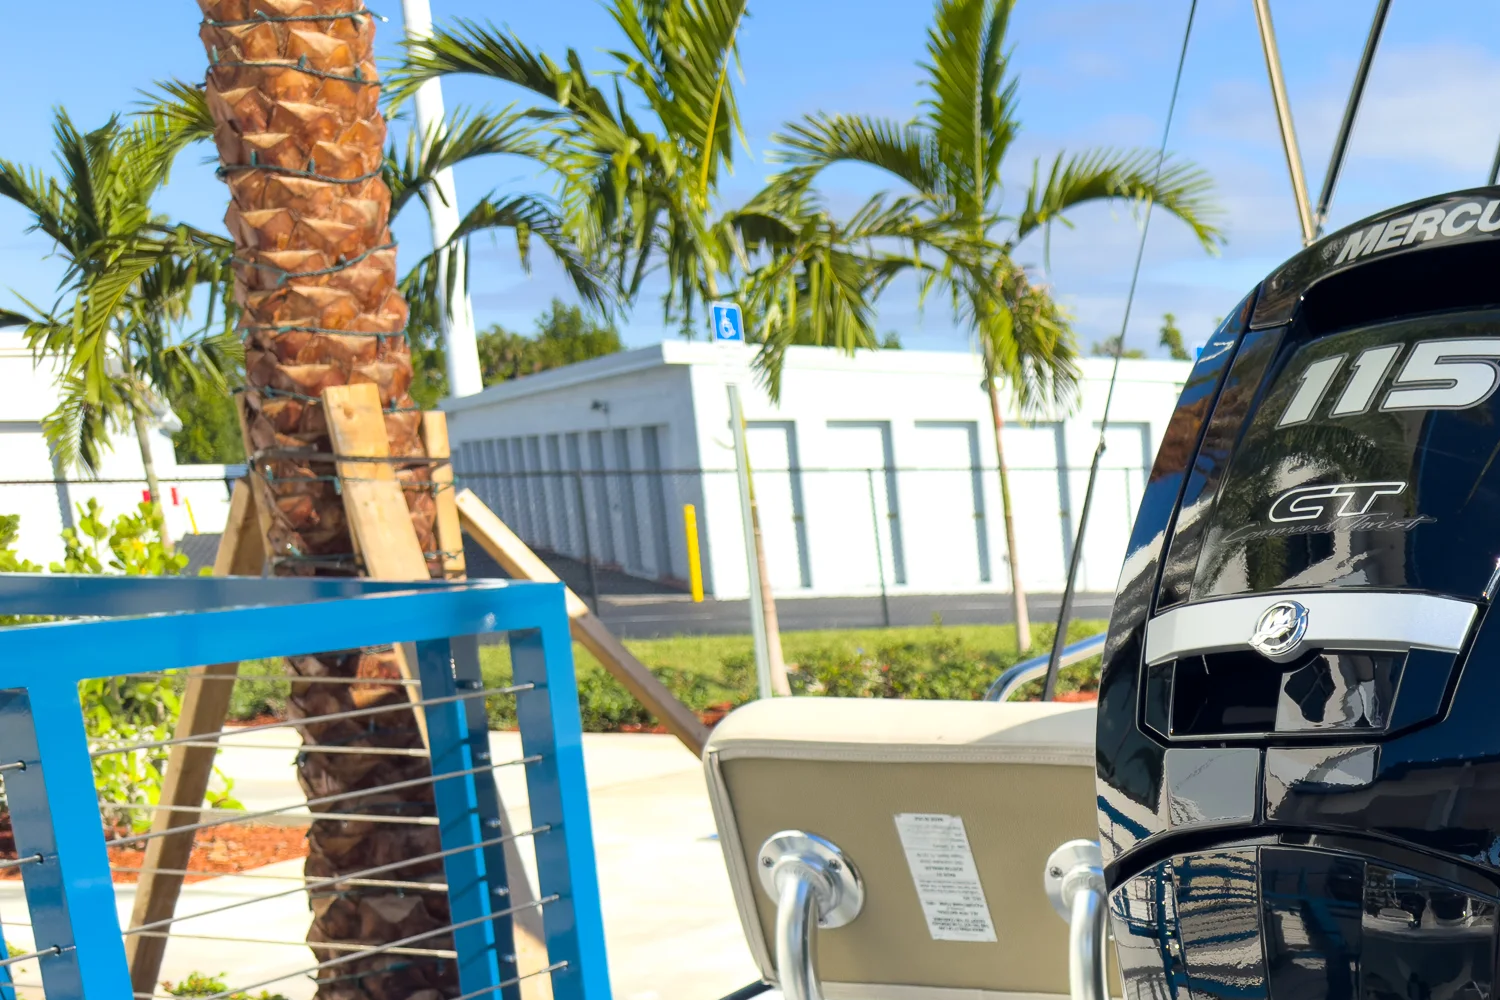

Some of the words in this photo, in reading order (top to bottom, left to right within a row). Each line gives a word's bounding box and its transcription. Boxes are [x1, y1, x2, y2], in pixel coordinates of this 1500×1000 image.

[1268, 481, 1408, 522] GT
[1221, 521, 1337, 544] Command
[1341, 512, 1438, 533] Thrust
